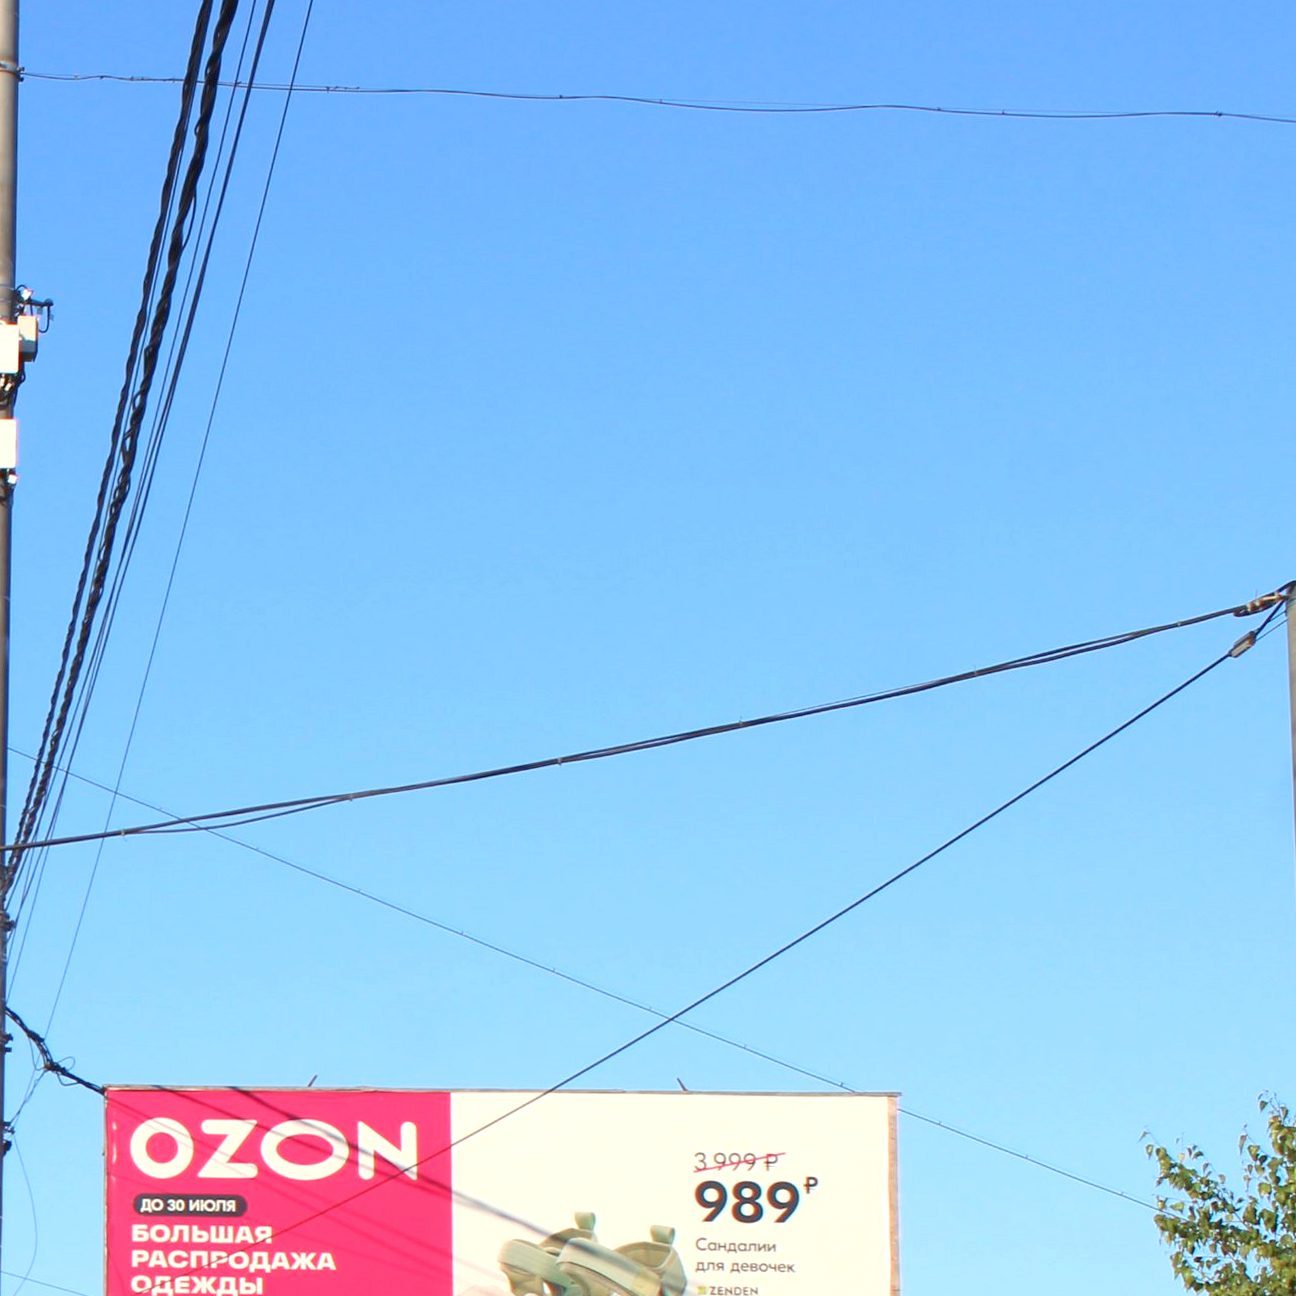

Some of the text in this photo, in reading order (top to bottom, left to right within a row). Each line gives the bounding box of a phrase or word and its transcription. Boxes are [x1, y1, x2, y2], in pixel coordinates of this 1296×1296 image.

[130, 1117, 418, 1181] OZON
[140, 1198, 236, 1214] ДО 30 ИЮЛЯ
[694, 1180, 800, 1224] 989
[131, 1223, 273, 1245] БОЛЬШАЯ
[695, 1237, 777, 1254] Сандалии
[131, 1250, 337, 1273] РАСПРОДАЖА
[695, 1261, 797, 1274] для девочек
[709, 1286, 759, 1296] ZENDEN
